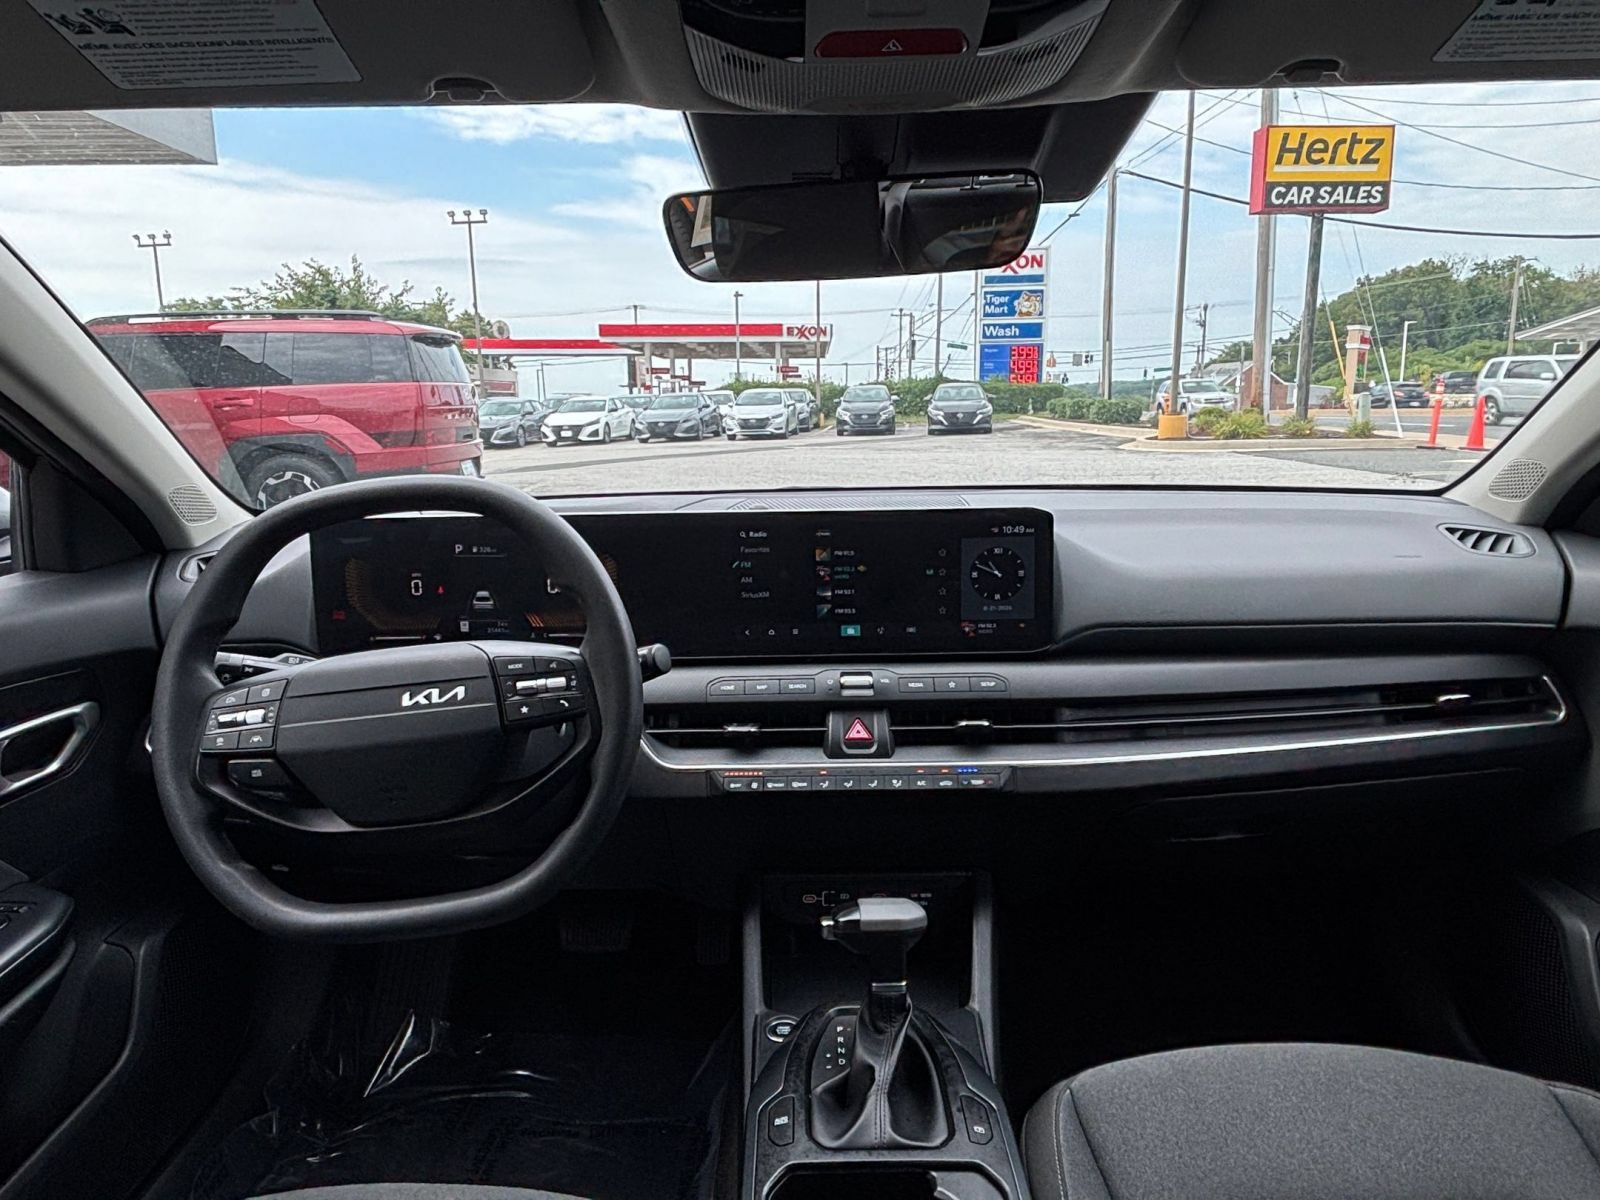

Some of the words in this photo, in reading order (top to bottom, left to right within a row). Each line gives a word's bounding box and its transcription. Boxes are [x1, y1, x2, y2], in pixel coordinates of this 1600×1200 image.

[1275, 132, 1385, 165] Hertz
[1271, 186, 1315, 205] CAR
[1317, 185, 1384, 205] SALES
[985, 294, 1010, 306] Tiger
[985, 304, 1009, 314] Mart
[786, 326, 828, 340] EXXON
[984, 325, 1020, 337] Wash
[1002, 525, 1025, 534] 10:49
[455, 544, 464, 554] P
